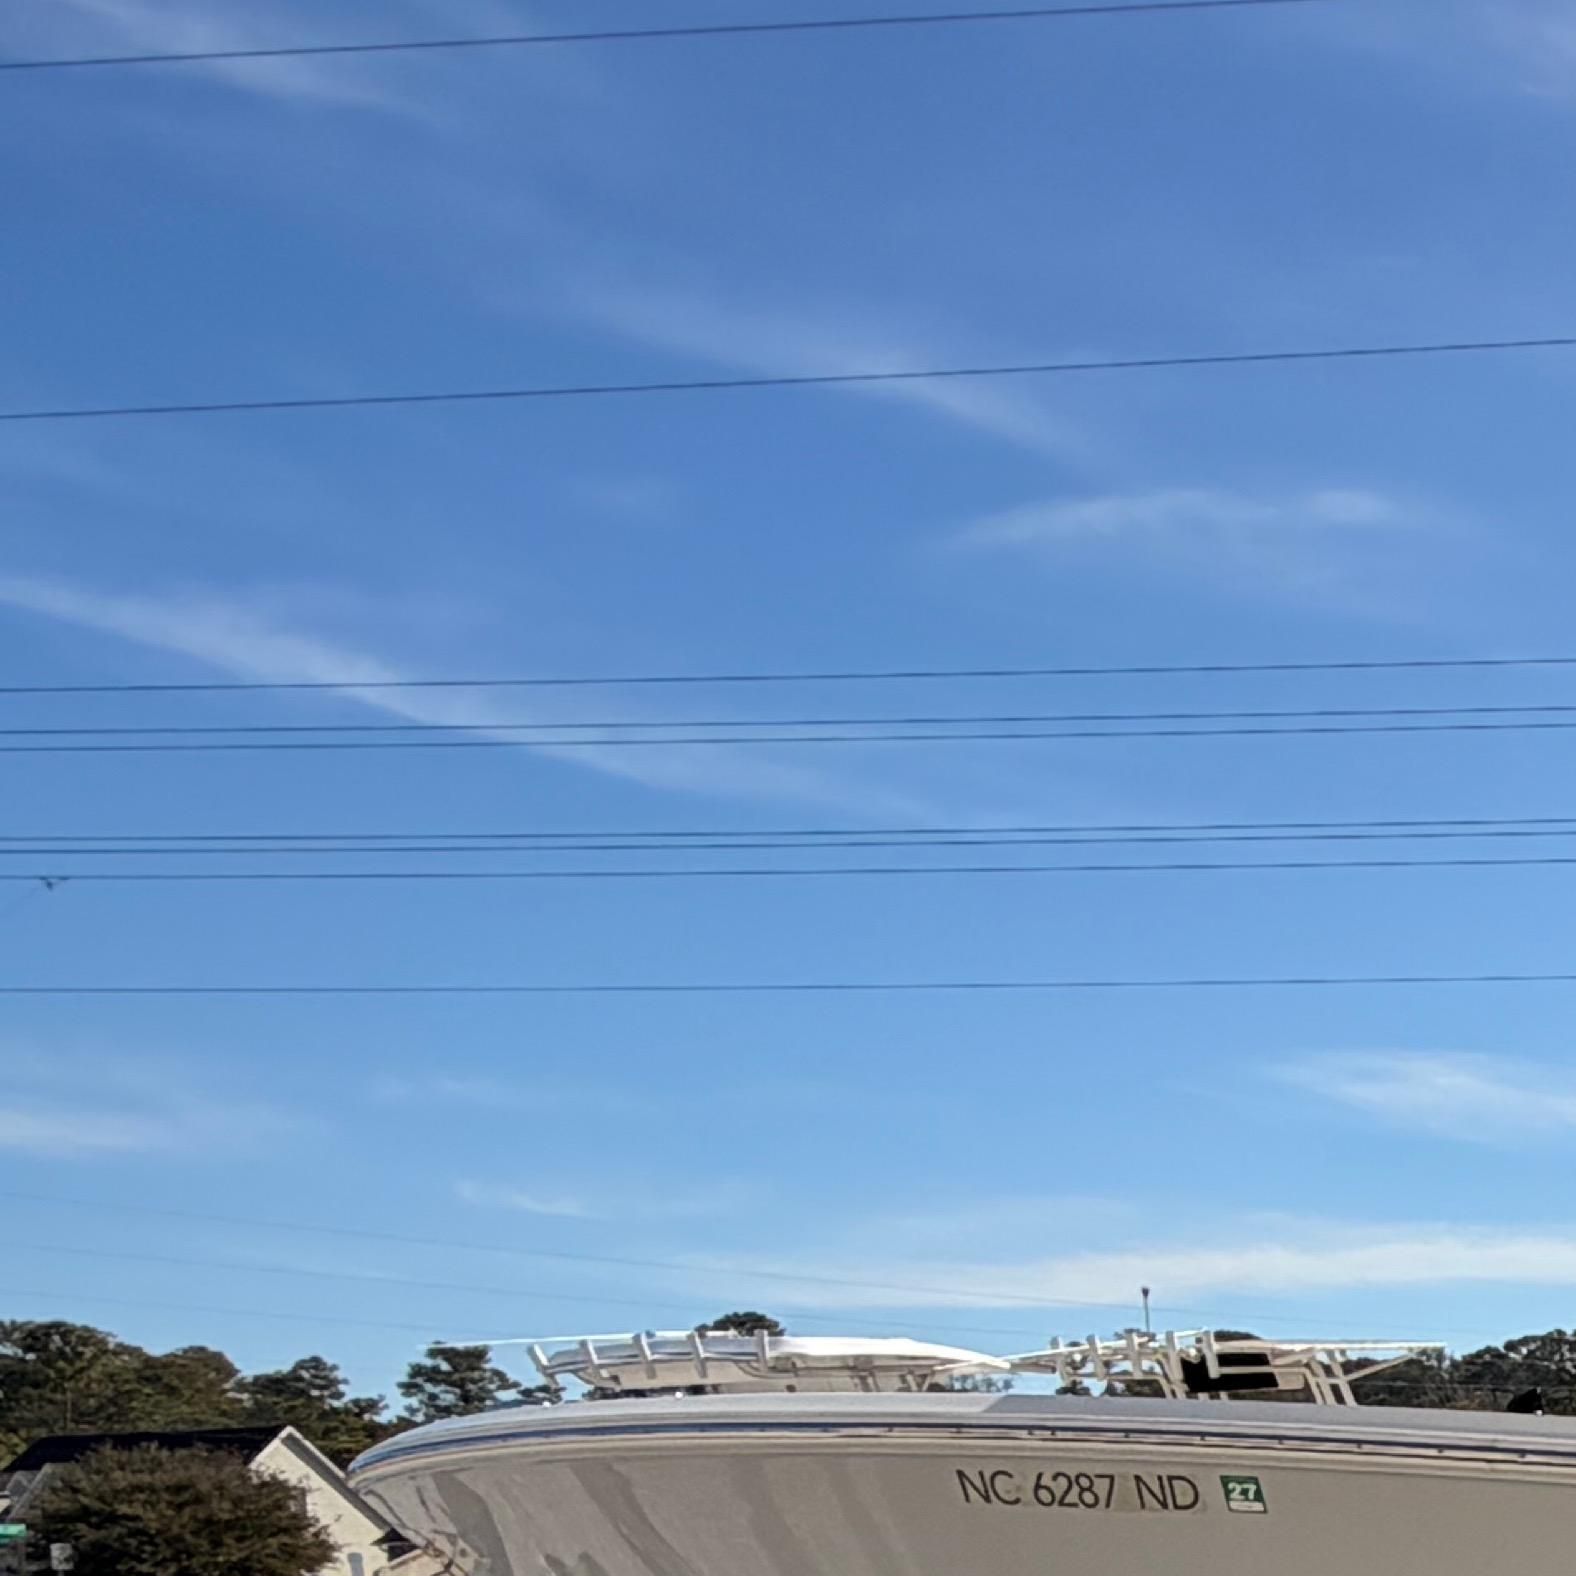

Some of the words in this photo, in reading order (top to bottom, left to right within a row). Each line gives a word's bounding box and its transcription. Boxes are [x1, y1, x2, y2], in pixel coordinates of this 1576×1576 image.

[955, 1469, 1022, 1506] NC
[1033, 1472, 1116, 1509] 6287
[1134, 1474, 1200, 1511] ND
[1228, 1482, 1257, 1500] 27
